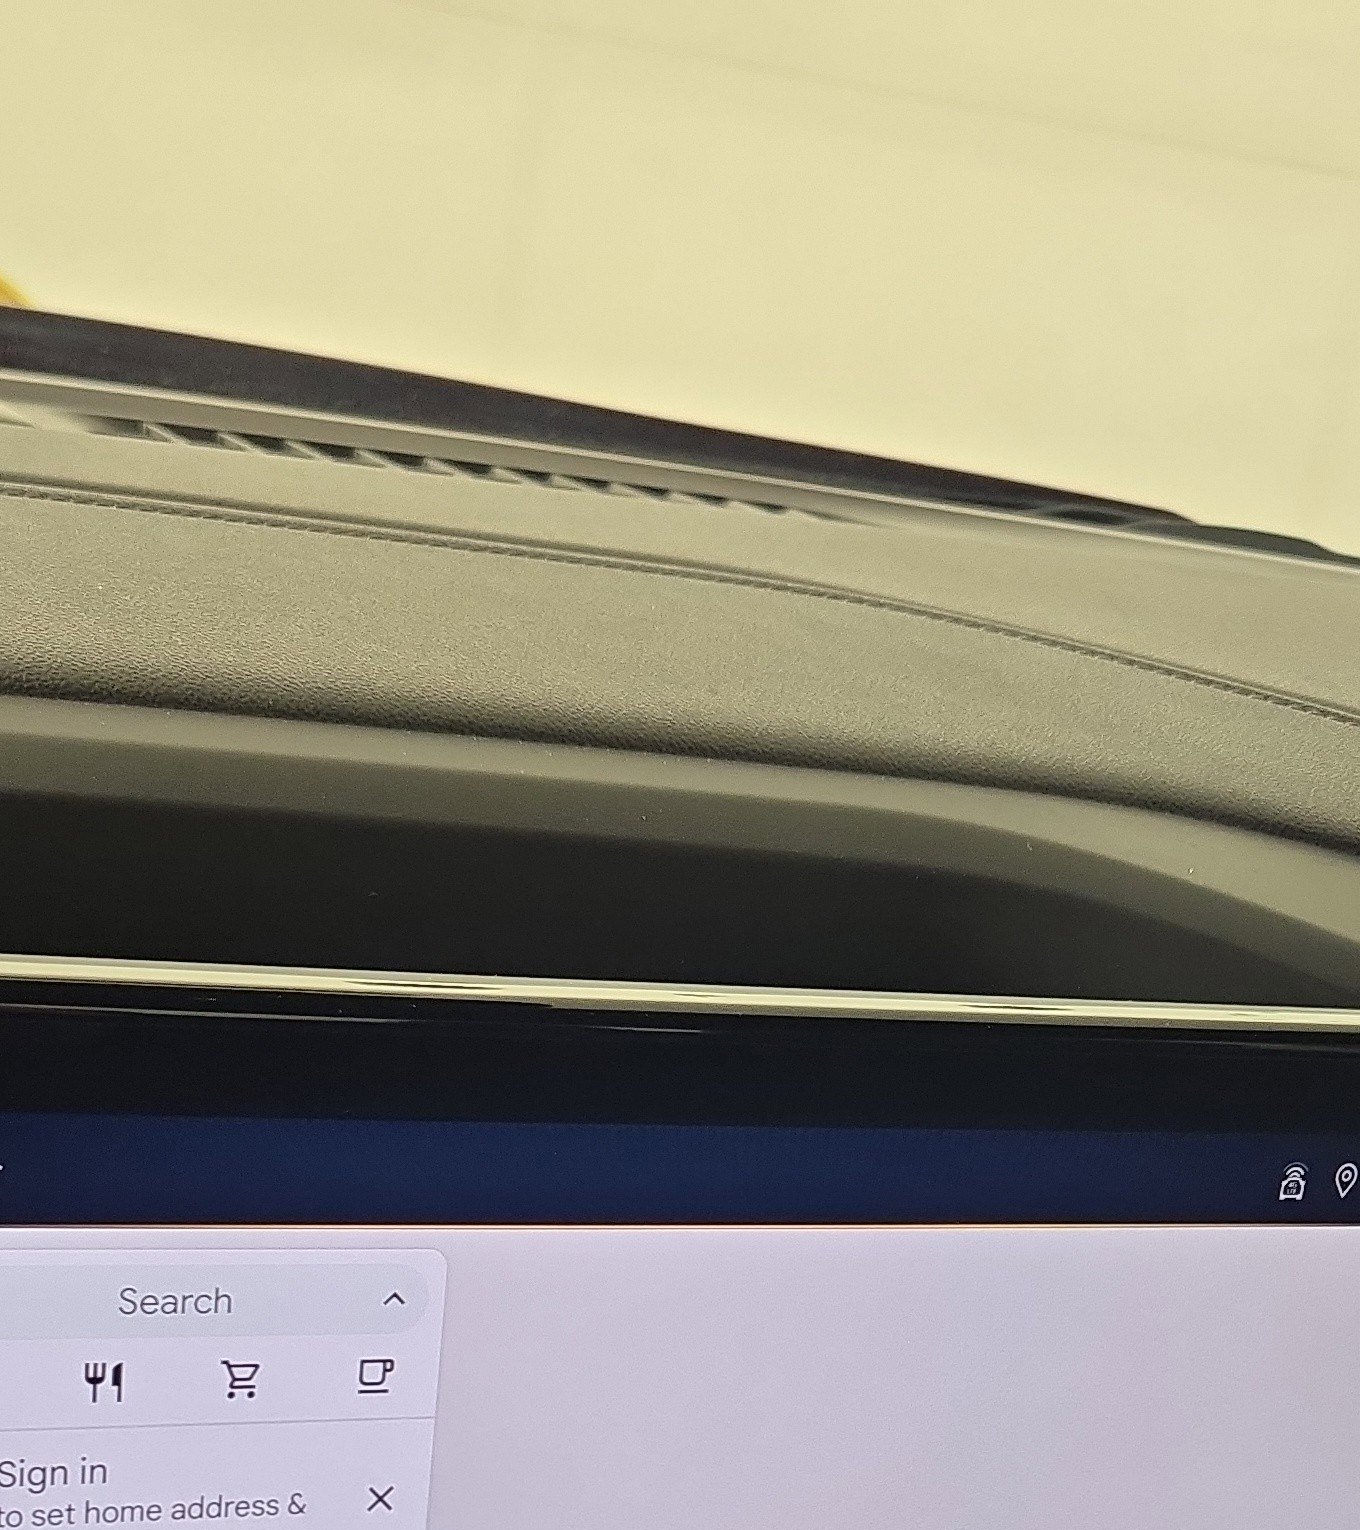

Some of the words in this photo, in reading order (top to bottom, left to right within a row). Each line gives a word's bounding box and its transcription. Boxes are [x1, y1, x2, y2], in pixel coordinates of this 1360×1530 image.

[118, 1286, 233, 1316] Search
[79, 1457, 108, 1486] in
[31, 1503, 76, 1528] set
[85, 1500, 162, 1525] home
[171, 1495, 279, 1520] address
[287, 1492, 308, 1515] &
